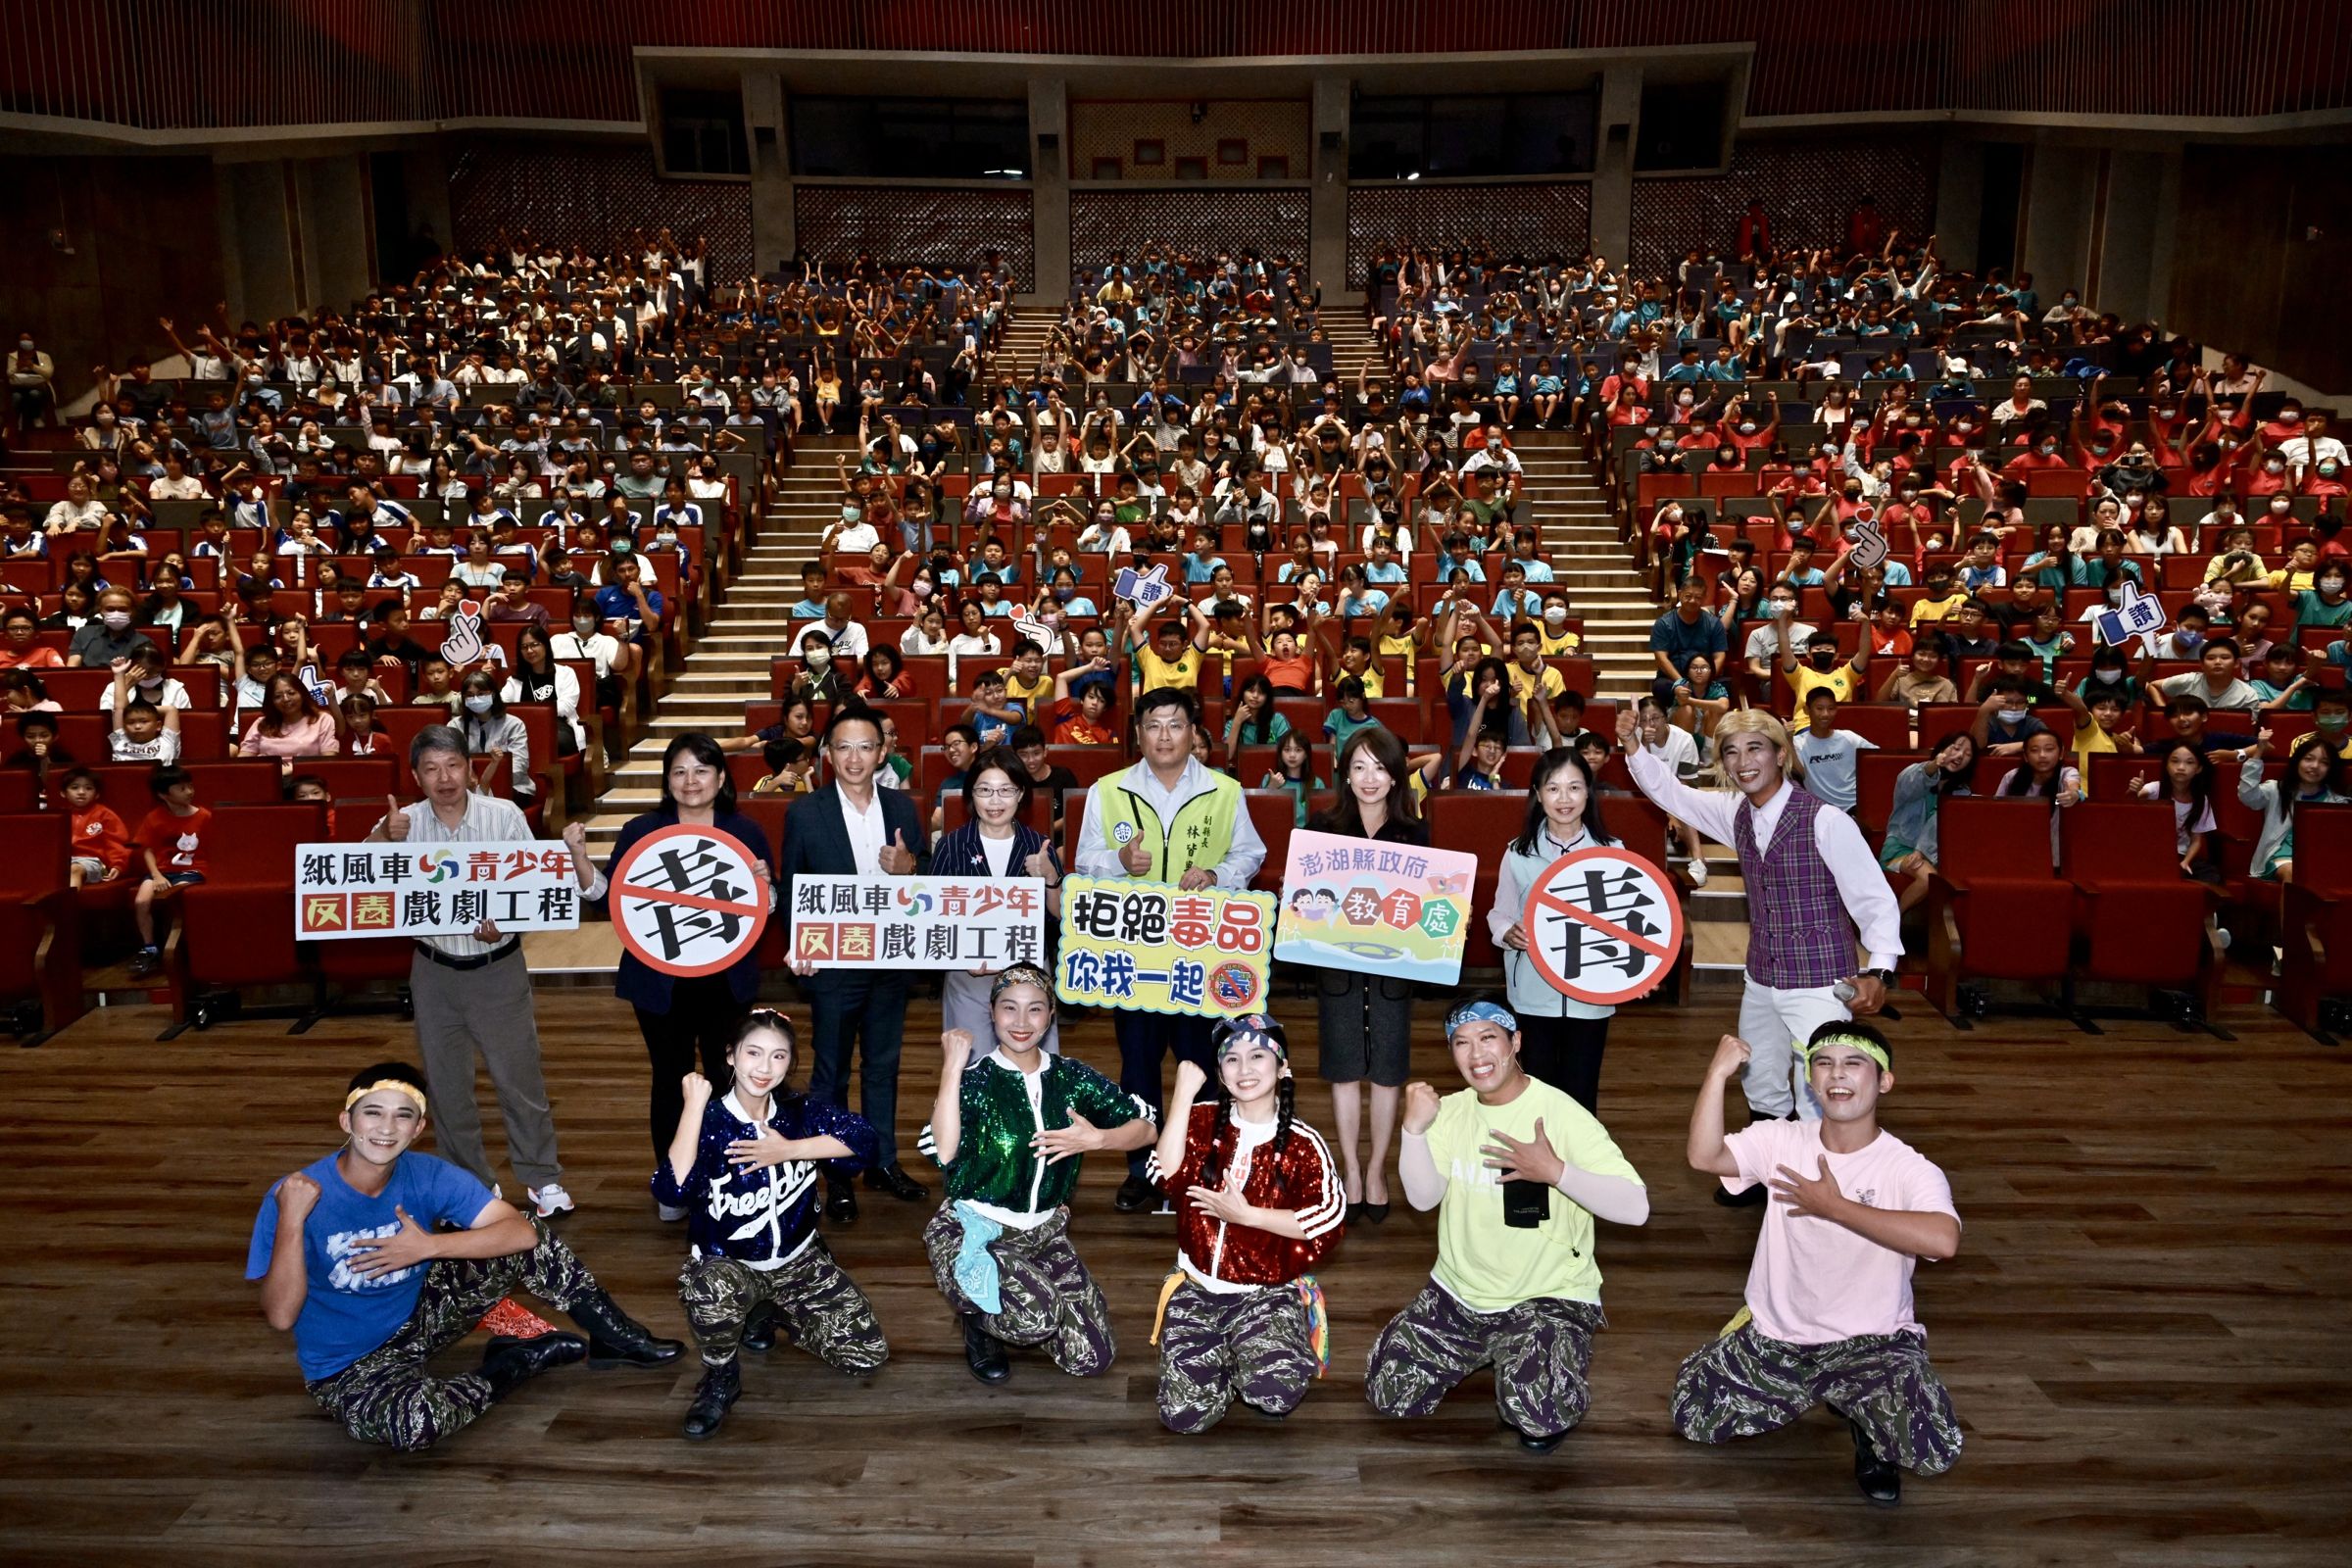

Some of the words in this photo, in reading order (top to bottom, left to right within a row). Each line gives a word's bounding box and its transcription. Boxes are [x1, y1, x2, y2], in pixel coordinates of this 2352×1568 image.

[2128, 601, 2155, 628] 讚
[302, 852, 414, 886] 紙風車
[466, 848, 574, 883] 青少年
[1298, 848, 1430, 879] 澎湖縣政府
[304, 887, 574, 930] 反毒戲劇工程
[797, 882, 892, 916] 紙風車
[938, 884, 1040, 917] 青少年
[1345, 892, 1450, 935] 教育處
[1074, 891, 1263, 954] 拒絕毒品
[799, 923, 1039, 961] 反毒戲劇工程
[1065, 949, 1204, 1007] 你我一起
